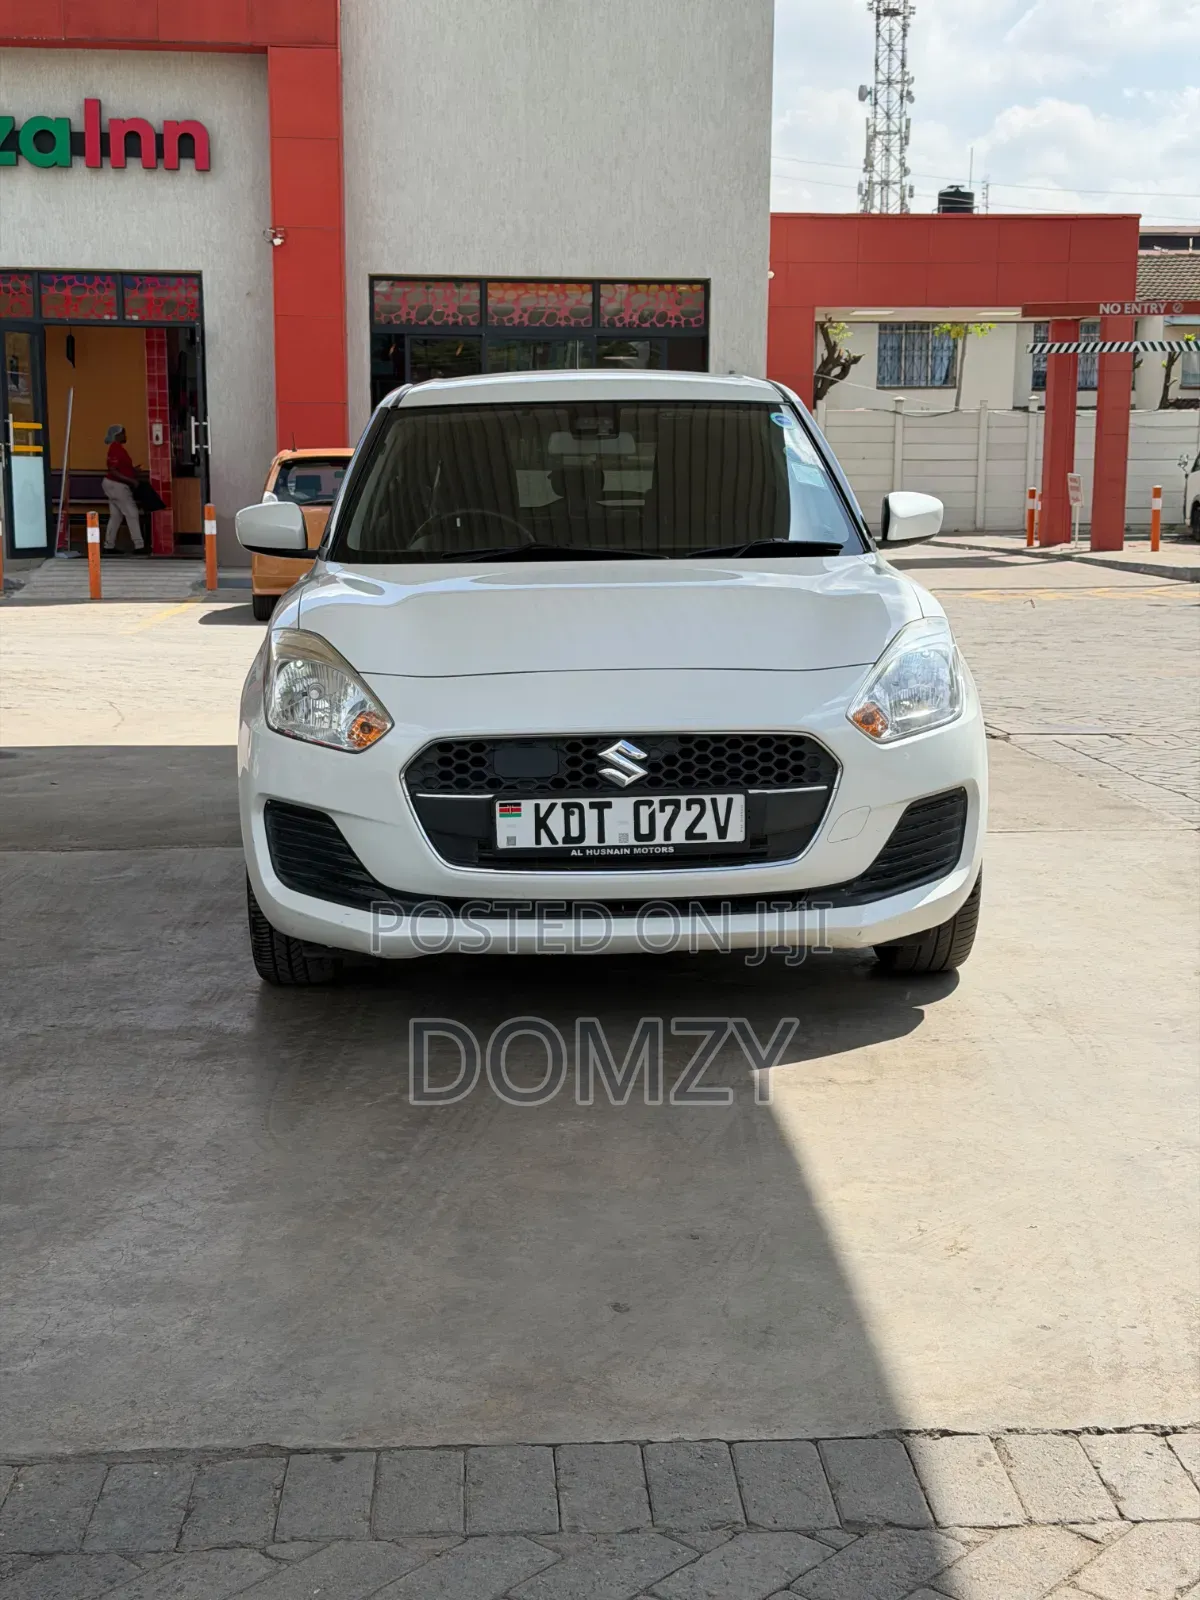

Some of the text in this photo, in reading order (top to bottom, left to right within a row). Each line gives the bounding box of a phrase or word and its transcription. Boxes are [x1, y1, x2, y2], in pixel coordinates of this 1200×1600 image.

[1099, 302, 1167, 314] NO ENTRY
[534, 801, 613, 845] KDT
[633, 797, 734, 842] 072V
[586, 848, 631, 856] HUSNAIN
[633, 846, 675, 854] MOTORS
